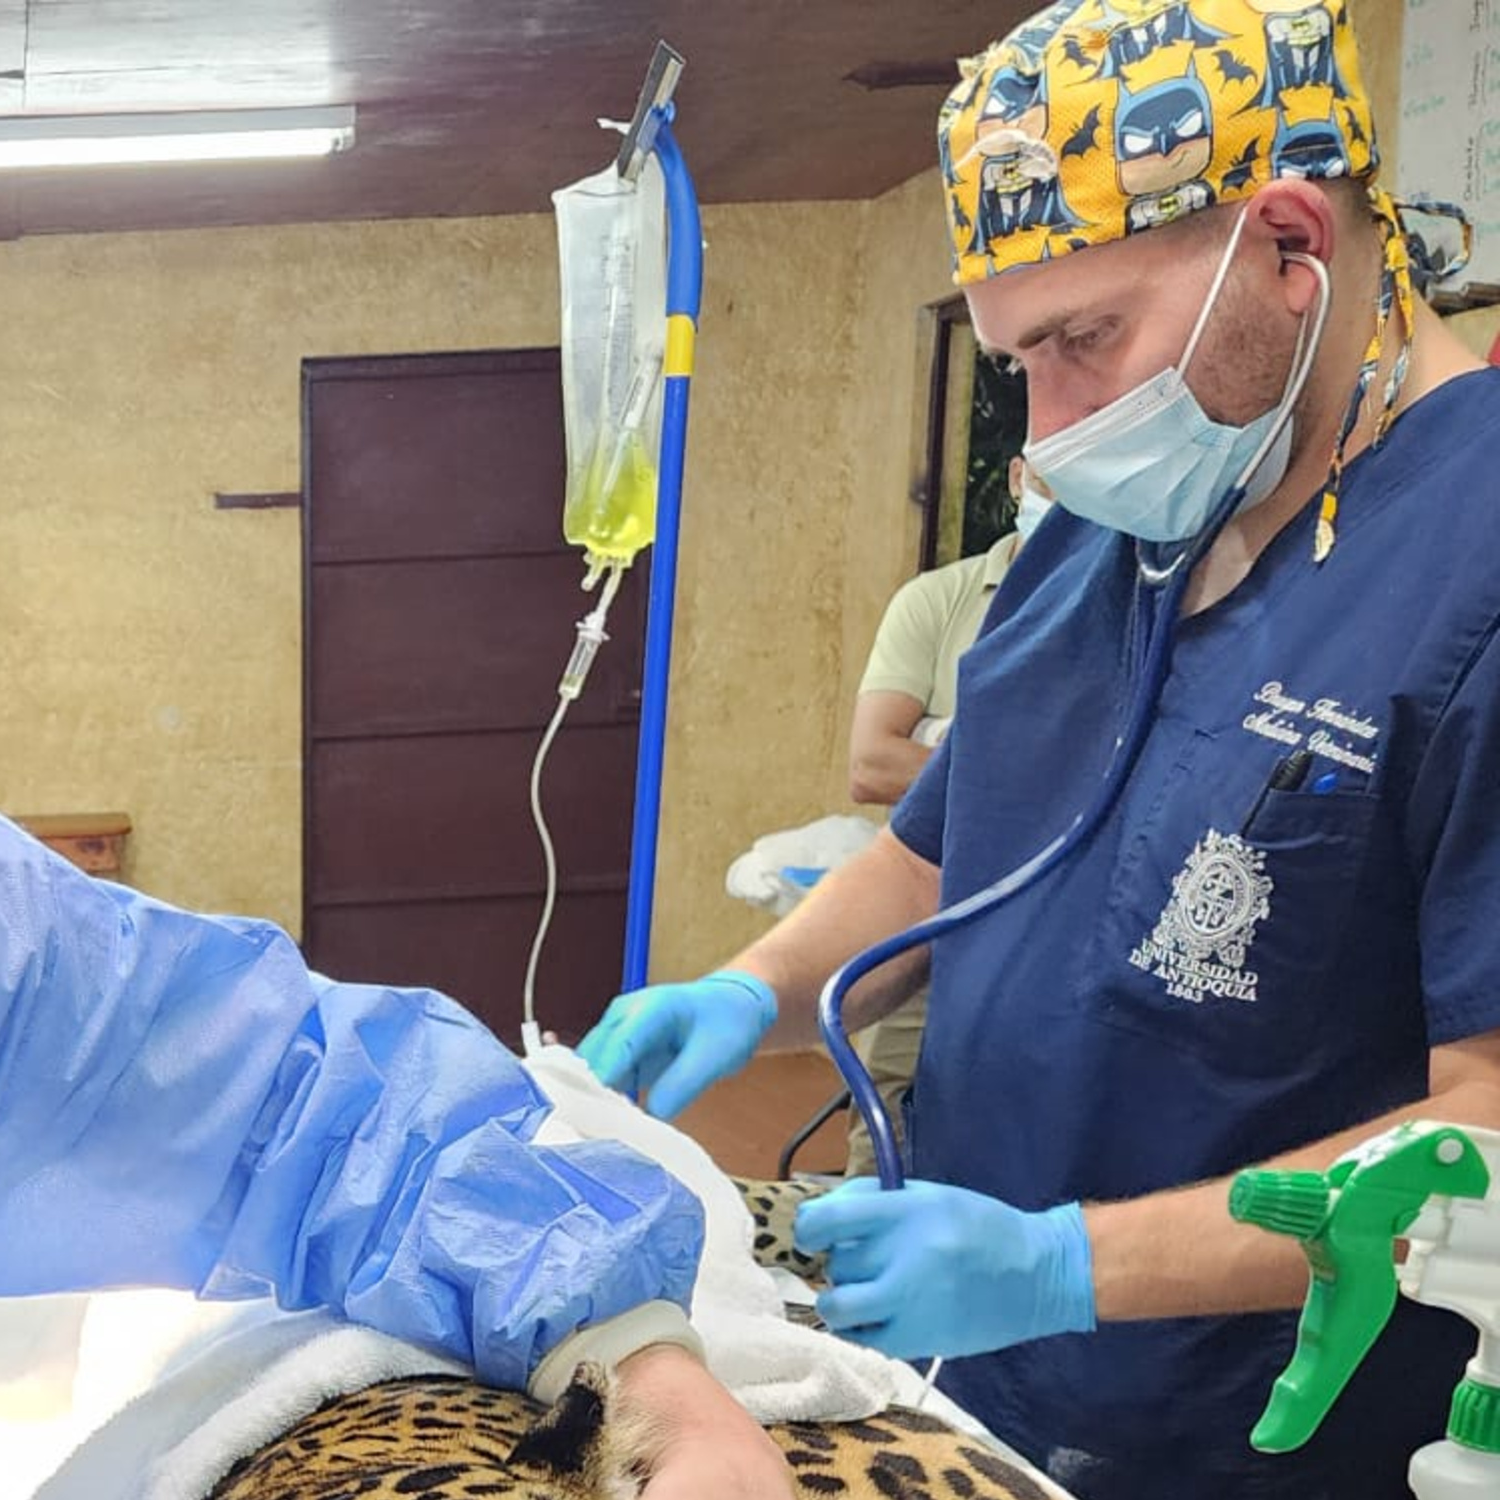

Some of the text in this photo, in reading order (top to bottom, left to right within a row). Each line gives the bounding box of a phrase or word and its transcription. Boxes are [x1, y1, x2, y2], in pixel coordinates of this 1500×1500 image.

[1141, 938, 1259, 986] UNIVERSIDAD
[1152, 963, 1258, 1002] ANTIOQUIA
[1164, 982, 1204, 1003] 1803
